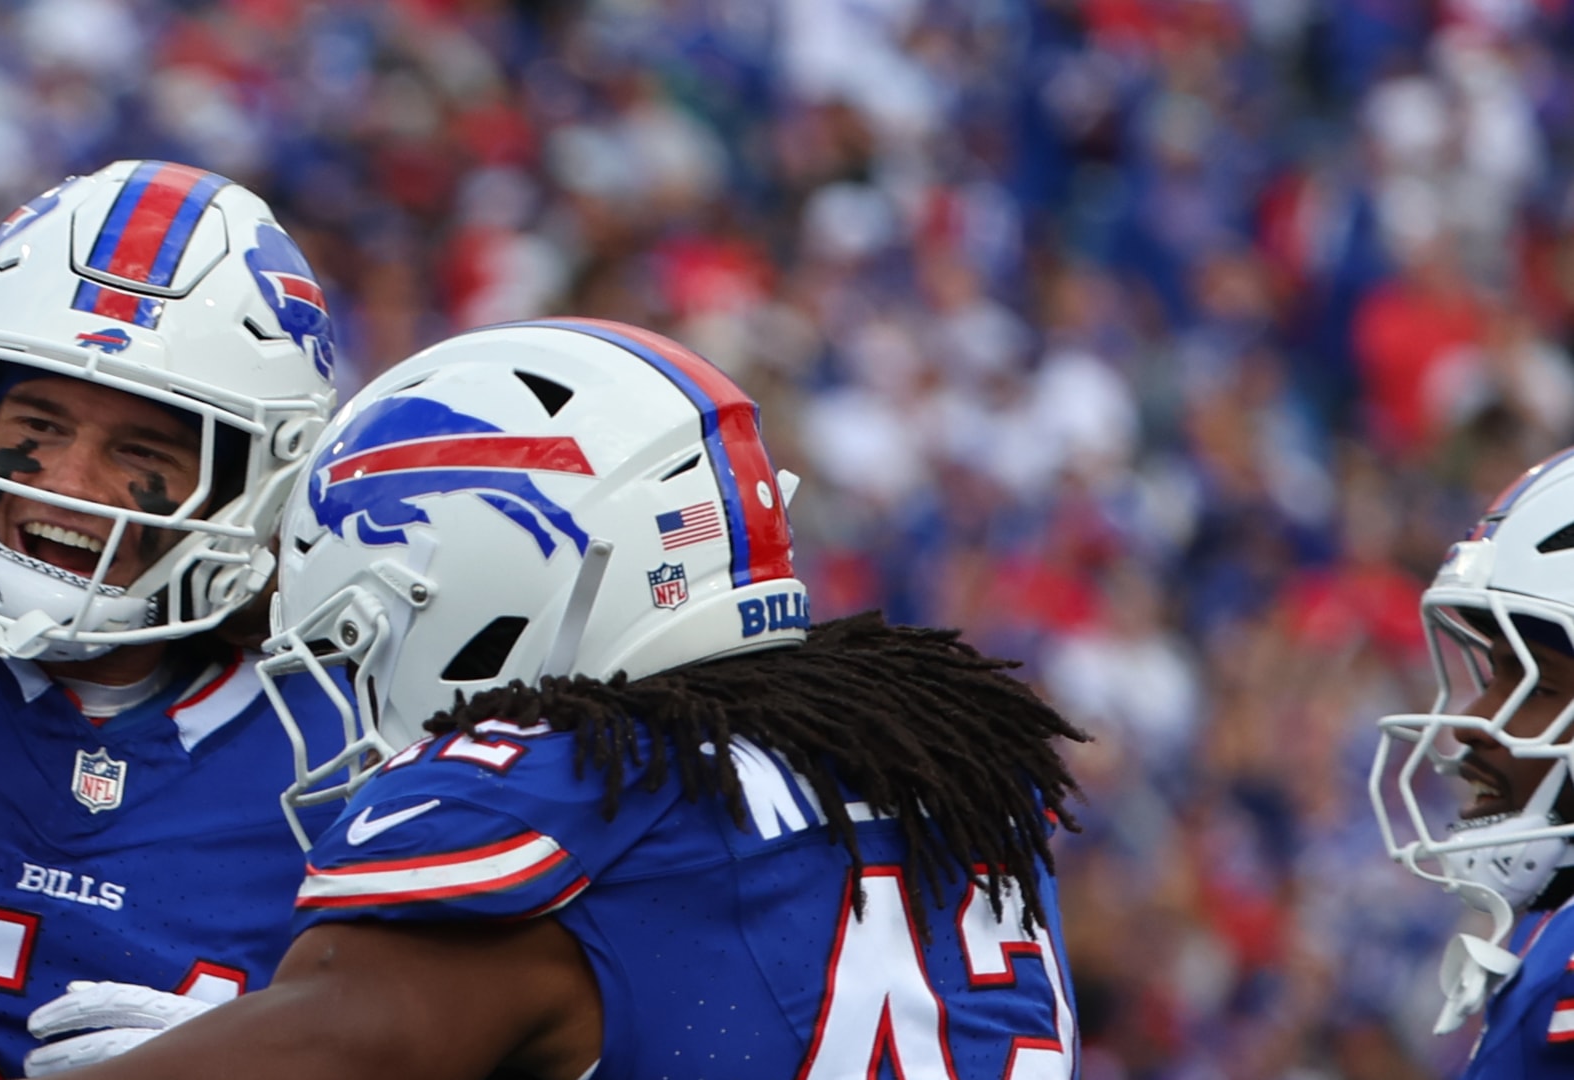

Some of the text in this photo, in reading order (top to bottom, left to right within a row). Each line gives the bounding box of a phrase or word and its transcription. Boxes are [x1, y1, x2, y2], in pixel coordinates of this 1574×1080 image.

[654, 580, 687, 606] NFL
[81, 774, 114, 802] NFL
[16, 861, 126, 911] BILLS
